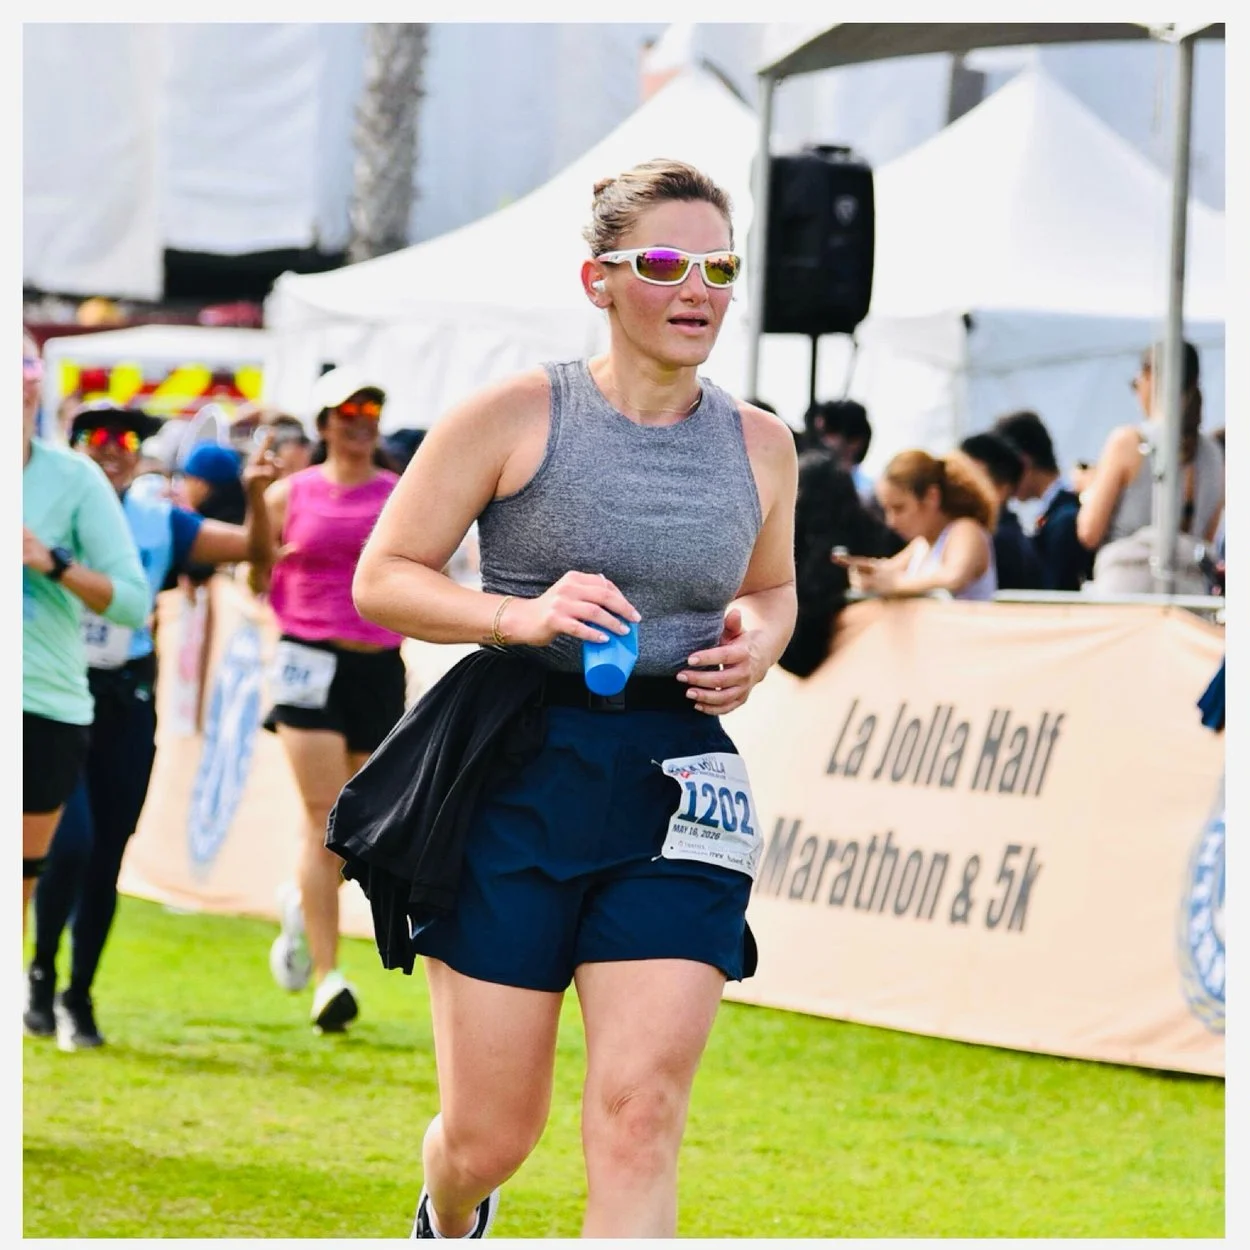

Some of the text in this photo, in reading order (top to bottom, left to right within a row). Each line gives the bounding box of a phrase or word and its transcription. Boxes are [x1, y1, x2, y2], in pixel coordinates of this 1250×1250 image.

[826, 700, 1066, 798] La Jolla Half
[677, 781, 754, 836] 1202
[755, 817, 1043, 932] Marathon & 5k
